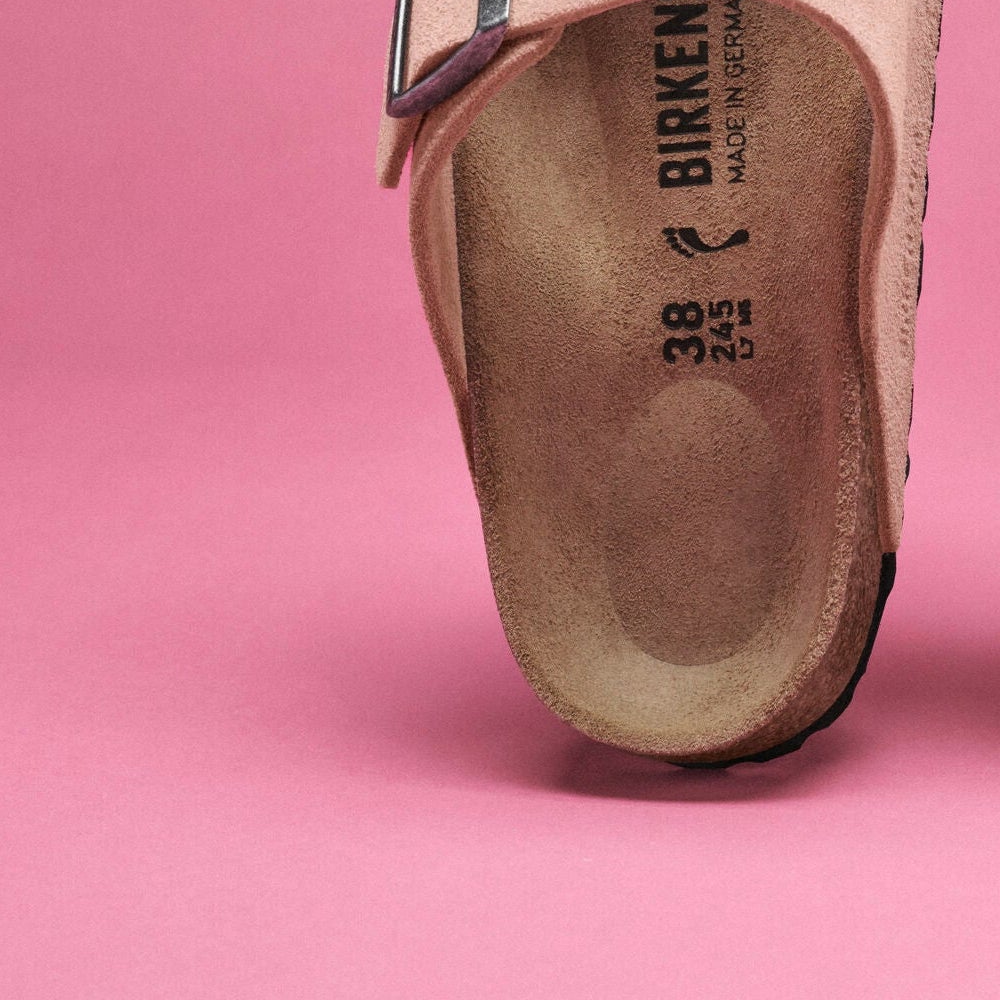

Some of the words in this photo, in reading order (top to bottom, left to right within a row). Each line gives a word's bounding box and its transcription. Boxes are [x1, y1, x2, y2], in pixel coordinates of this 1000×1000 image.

[724, 86, 745, 109] IN
[725, 116, 747, 184] MADE
[661, 300, 706, 364] 38
[708, 300, 736, 363] 245
